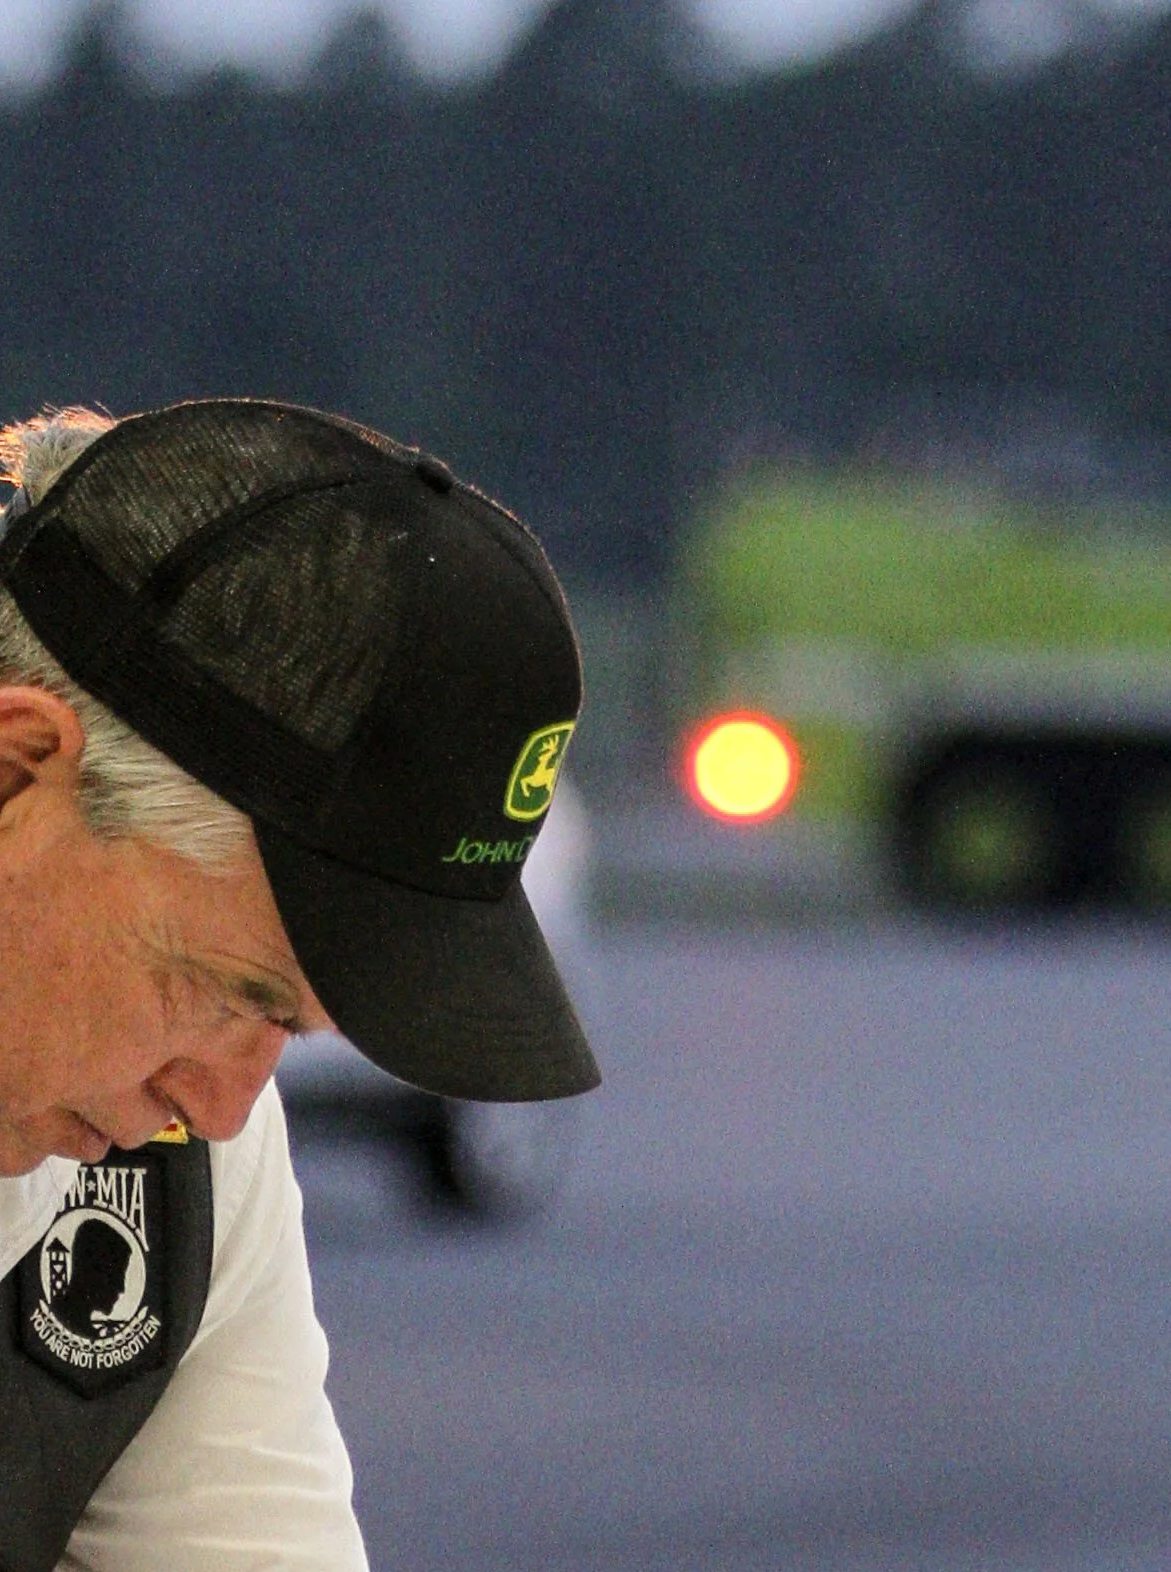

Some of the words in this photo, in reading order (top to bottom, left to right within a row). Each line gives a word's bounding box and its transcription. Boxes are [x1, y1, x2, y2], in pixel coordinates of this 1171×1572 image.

[442, 837, 518, 863] JOHN
[30, 1308, 52, 1341] YOU
[44, 1334, 71, 1362] ARE
[70, 1347, 95, 1370] NOT
[95, 1314, 162, 1369] FORGOTTEN
